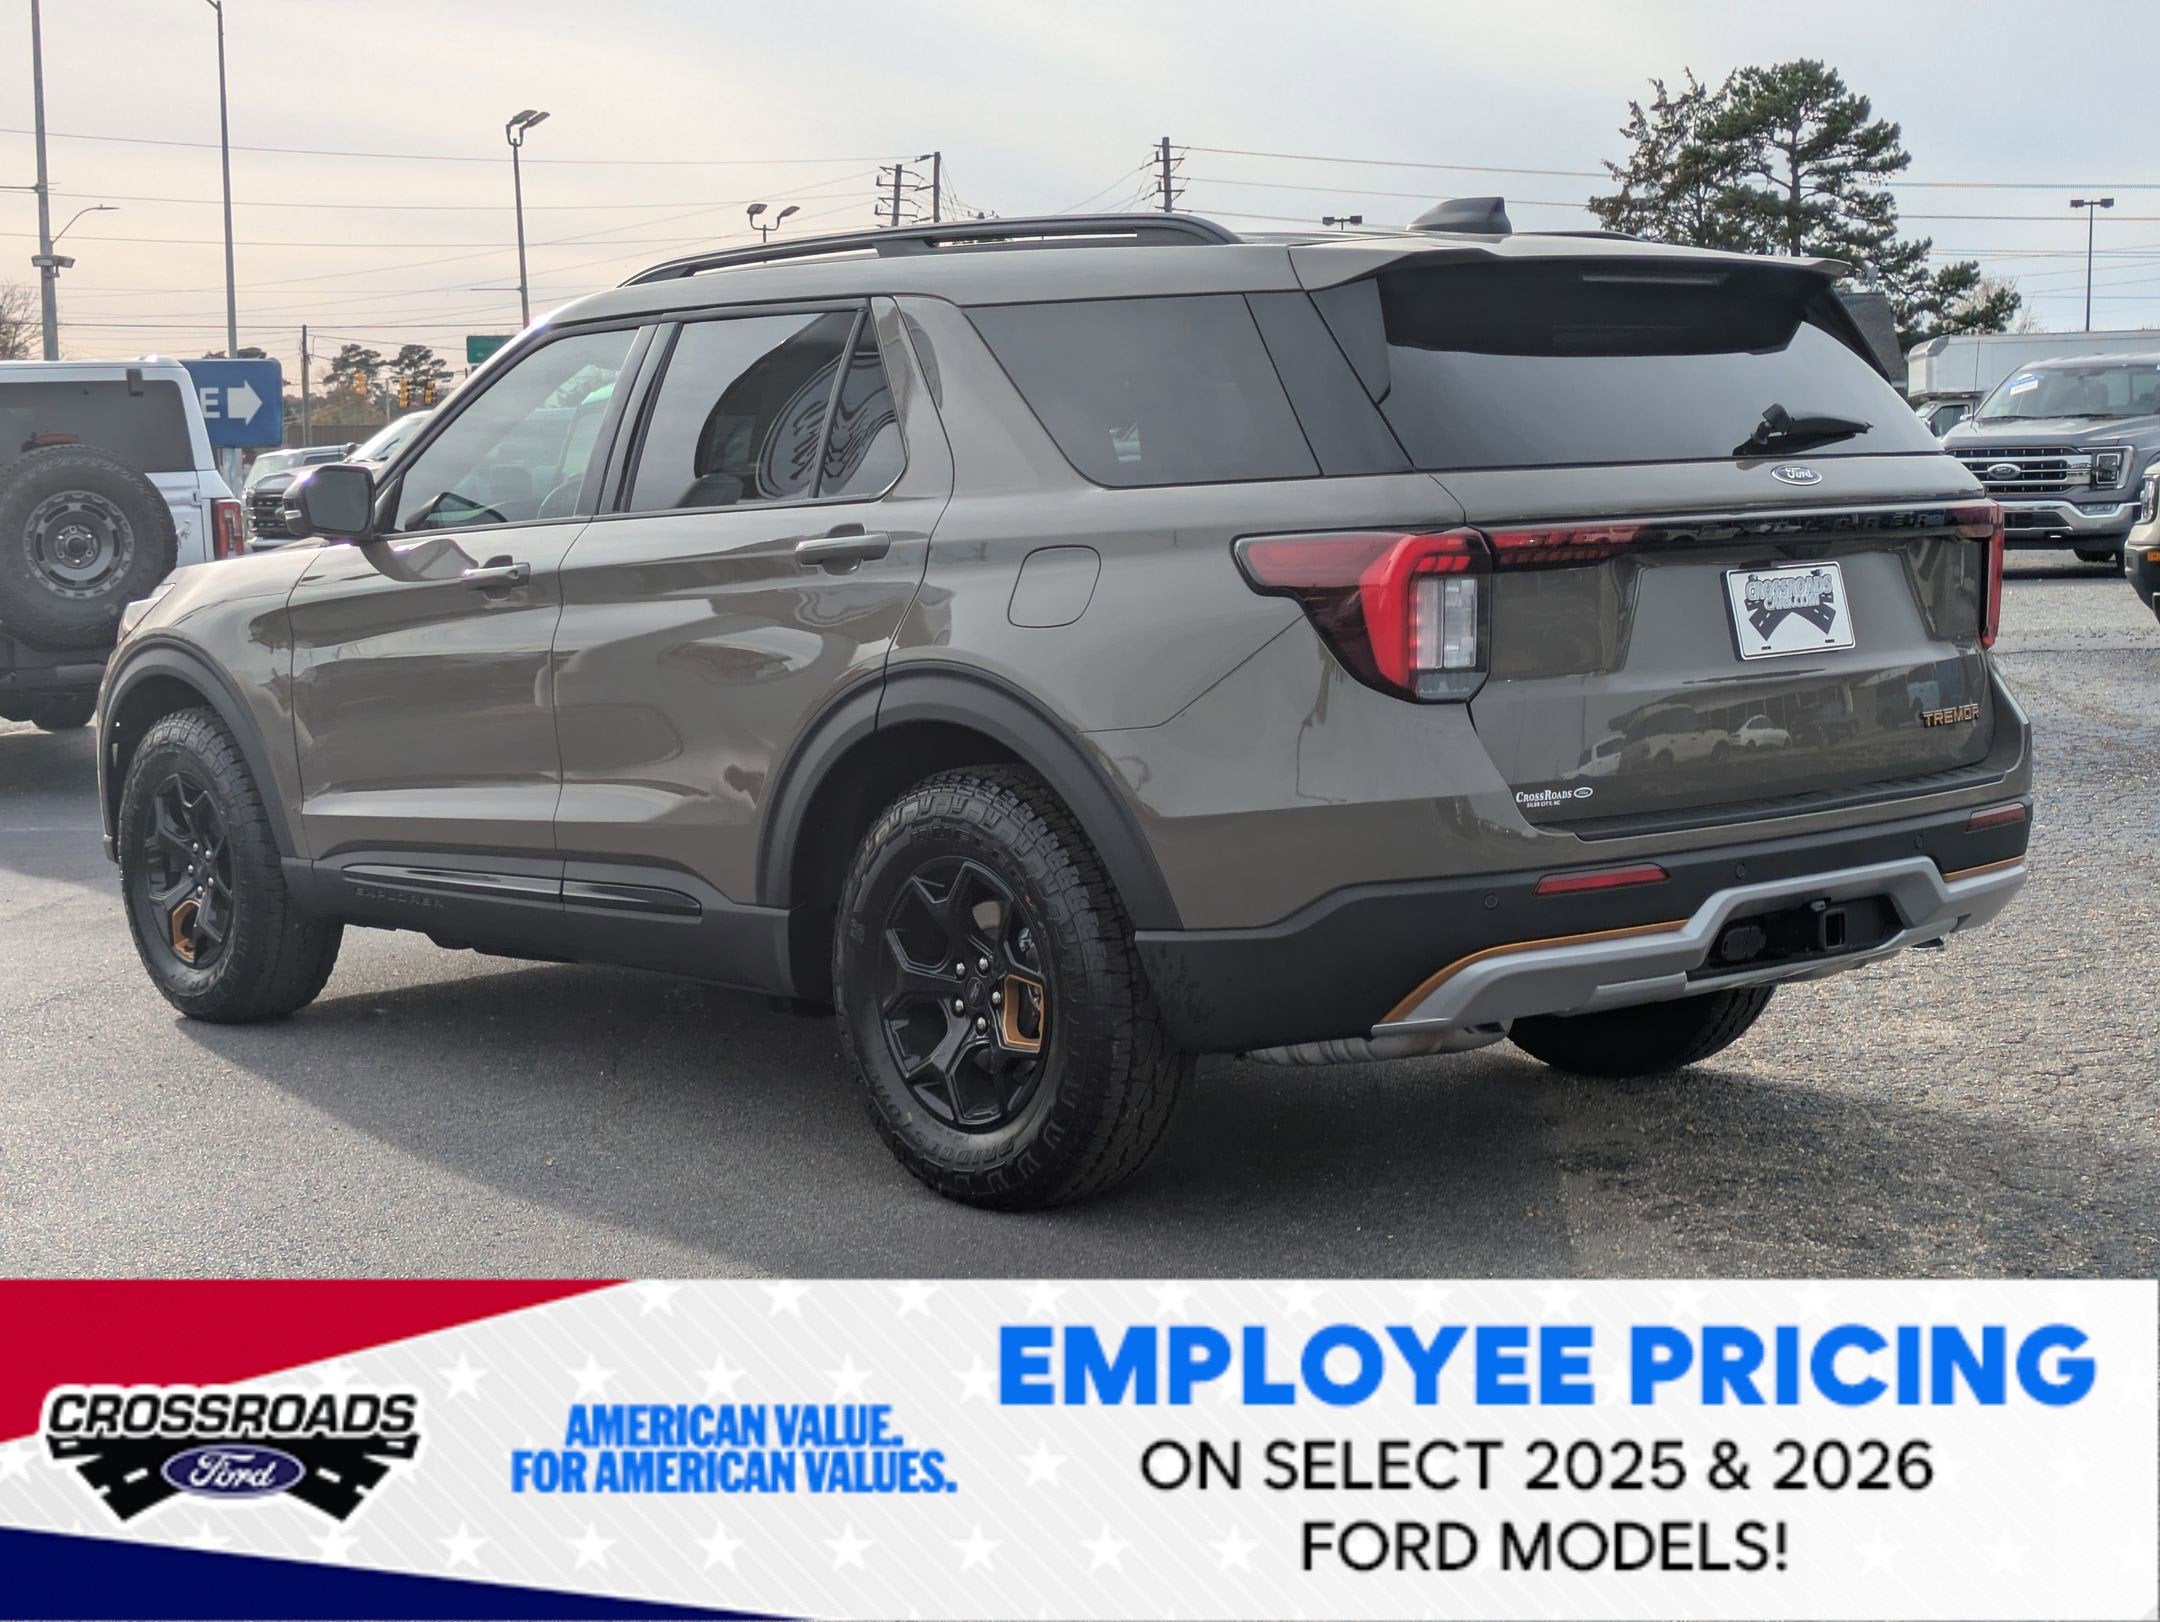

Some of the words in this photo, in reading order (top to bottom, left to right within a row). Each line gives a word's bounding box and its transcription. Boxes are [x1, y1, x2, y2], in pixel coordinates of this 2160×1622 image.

[1785, 467, 1813, 479] Ford
[1745, 574, 1834, 601] CROSSROADS
[1922, 703, 1979, 727] TREMOR
